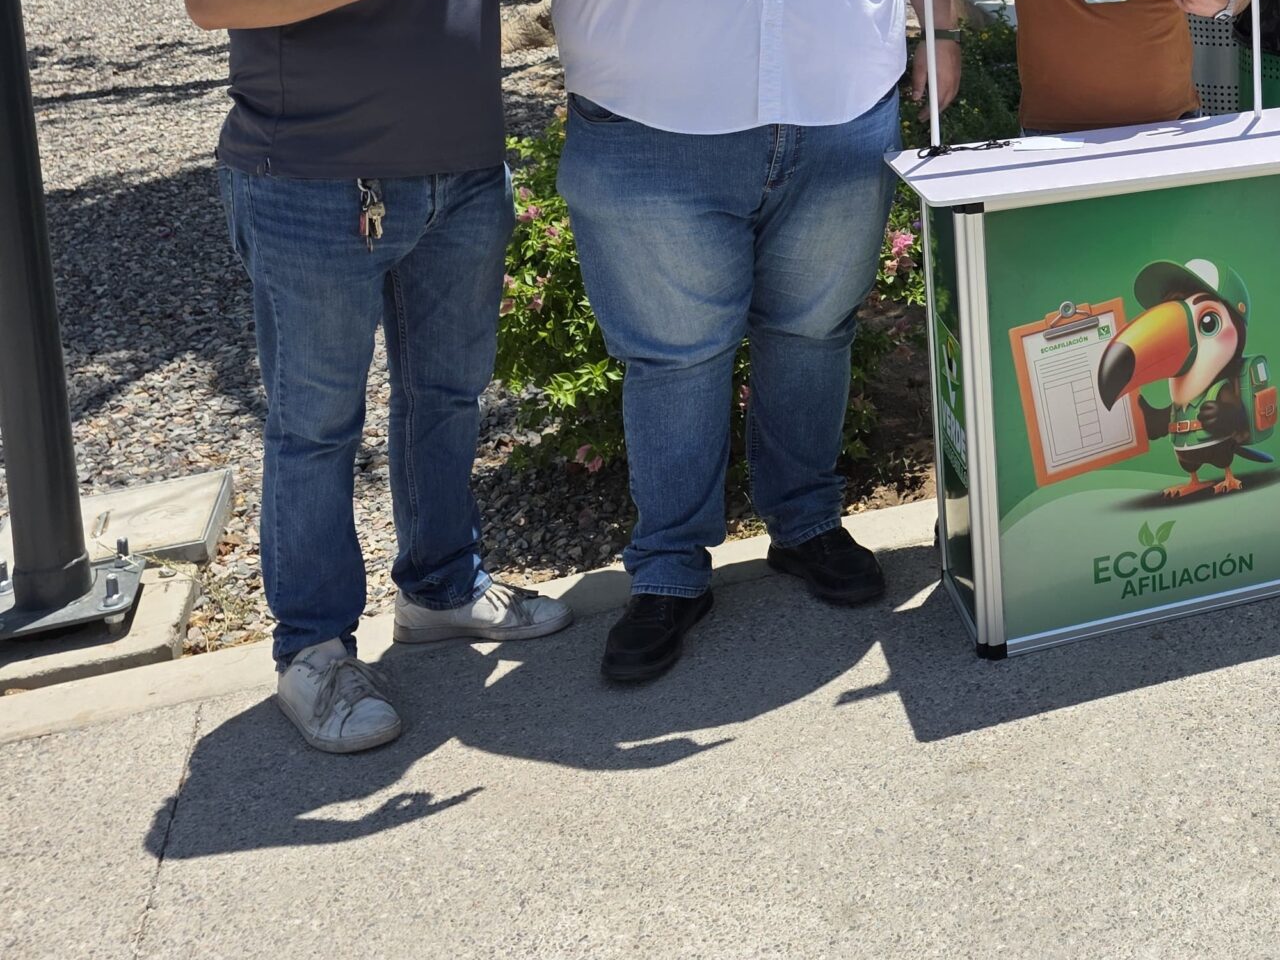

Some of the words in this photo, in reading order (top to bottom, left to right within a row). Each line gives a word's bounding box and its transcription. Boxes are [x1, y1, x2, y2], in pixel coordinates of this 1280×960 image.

[1040, 336, 1089, 354] ECOAFILIACIÓN
[1093, 545, 1168, 584] ECO
[1121, 553, 1254, 600] AFILIACIÓN
